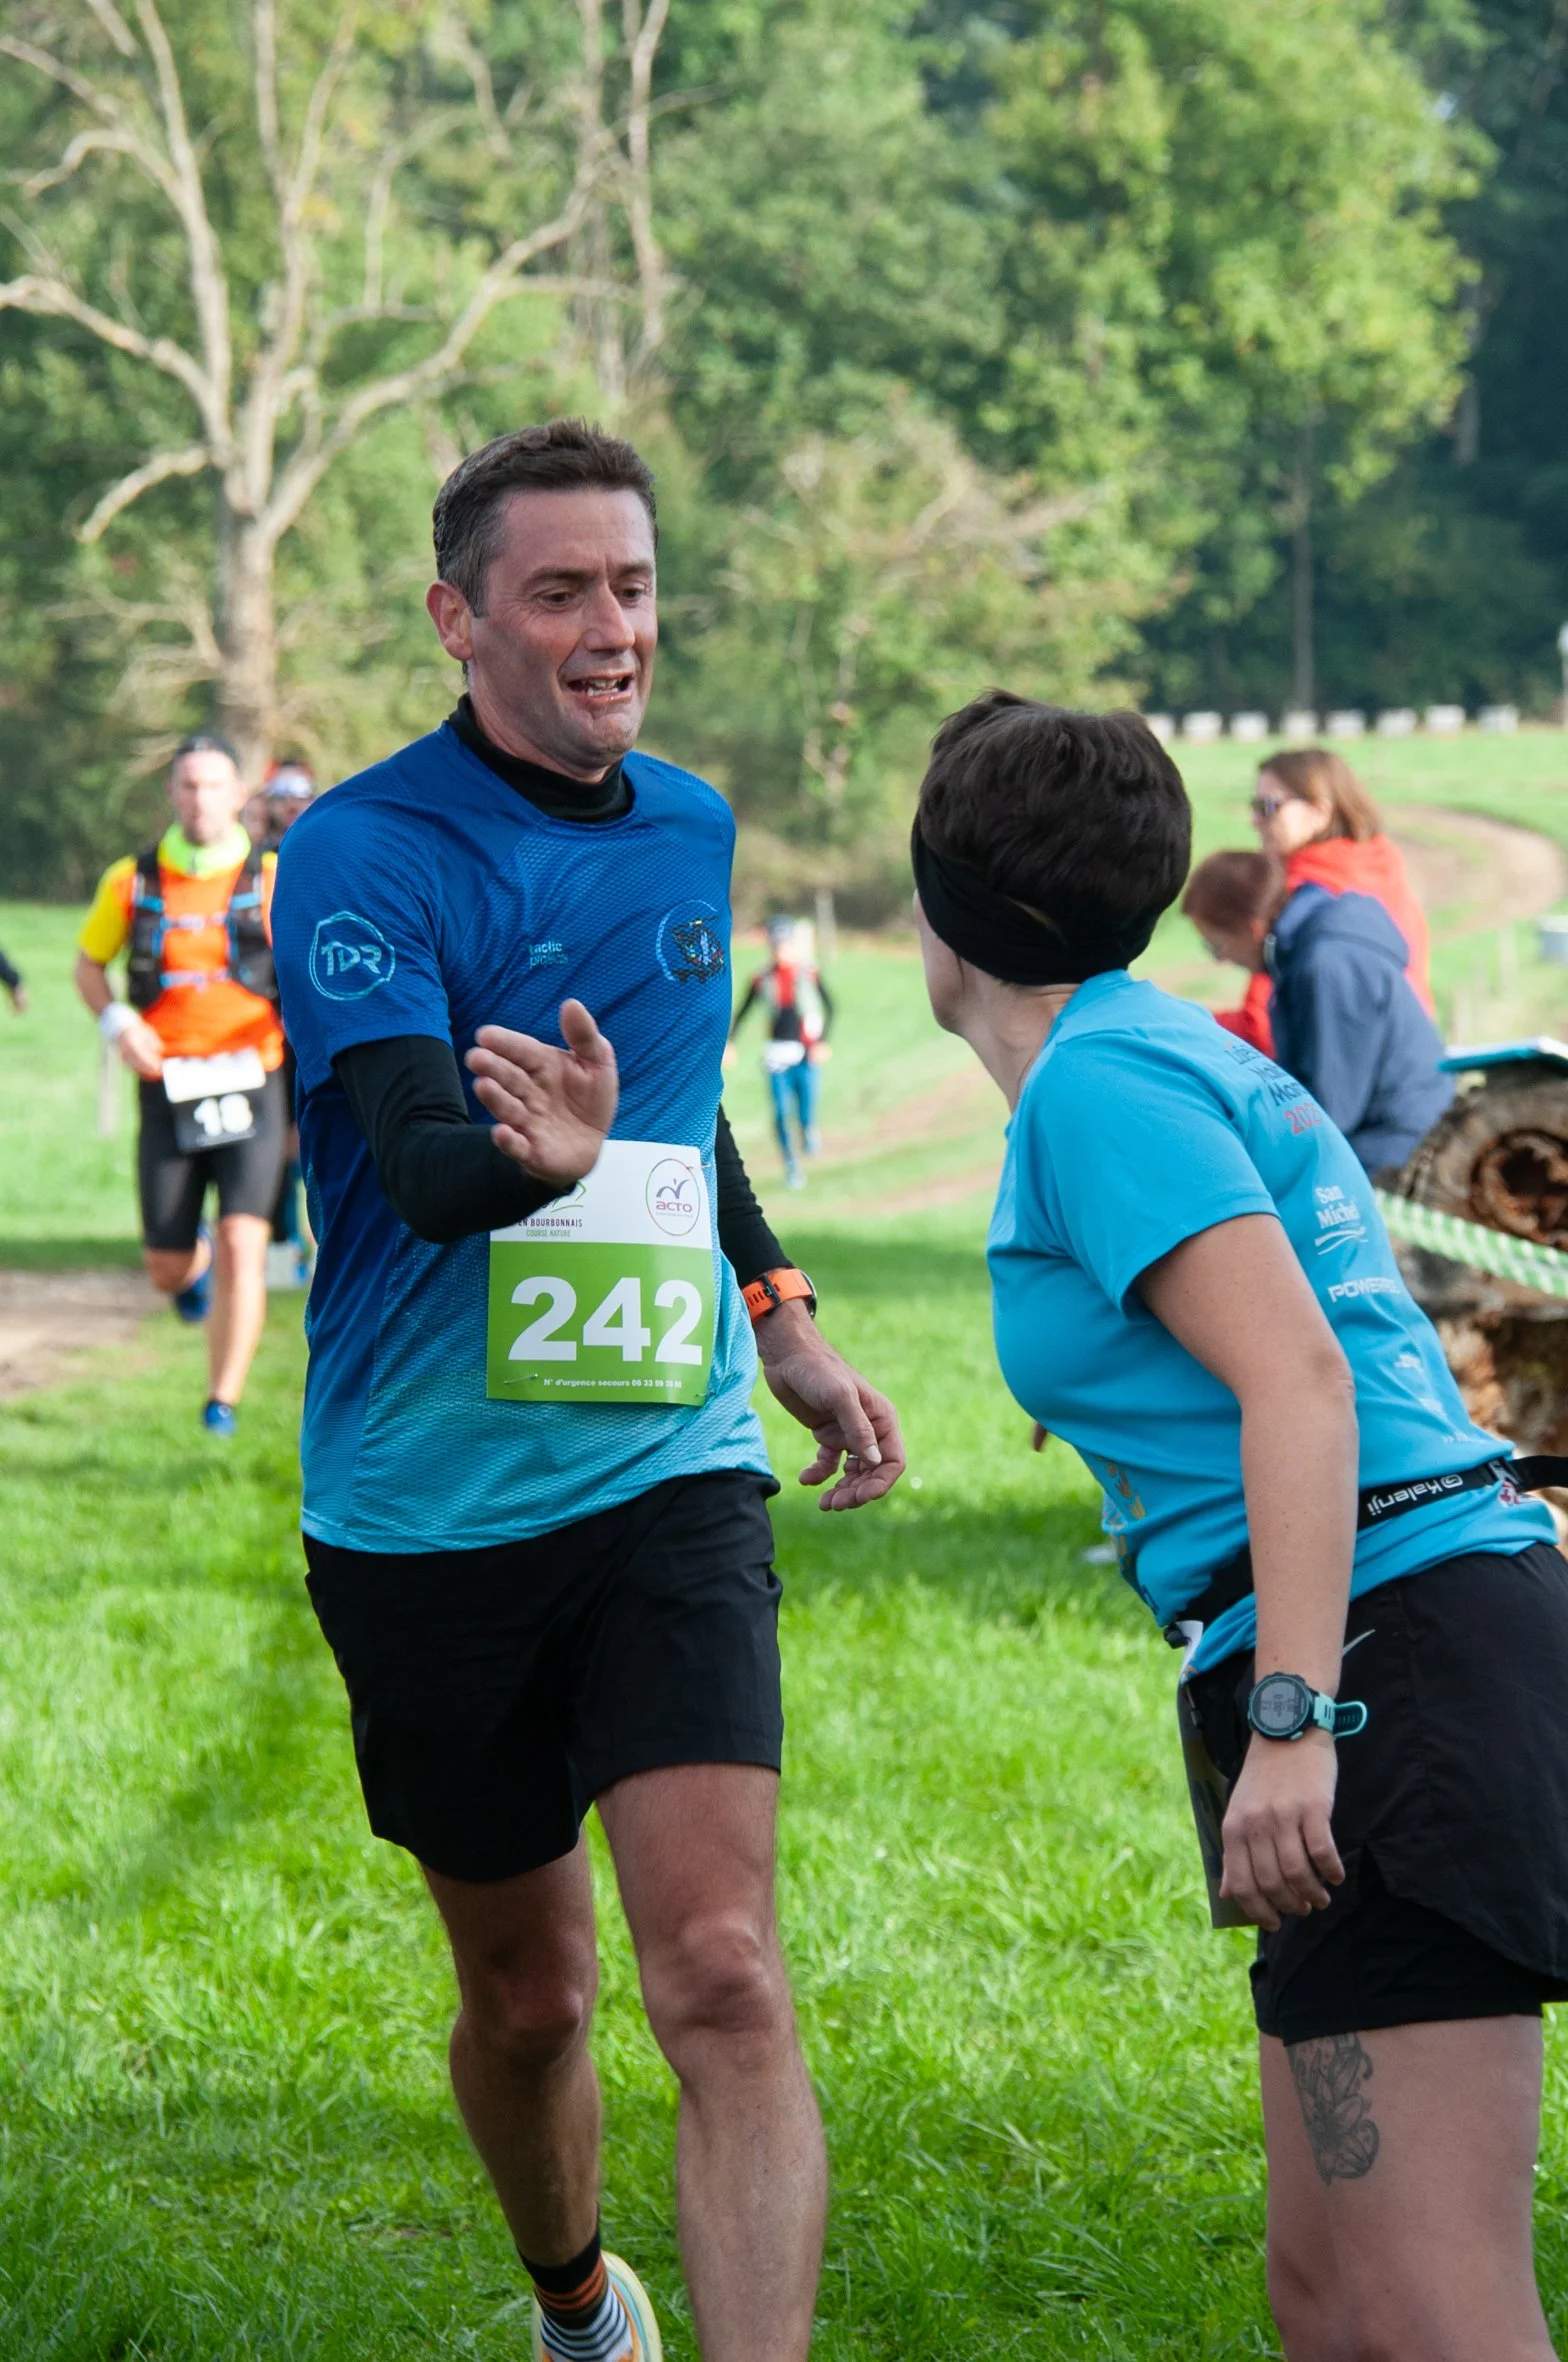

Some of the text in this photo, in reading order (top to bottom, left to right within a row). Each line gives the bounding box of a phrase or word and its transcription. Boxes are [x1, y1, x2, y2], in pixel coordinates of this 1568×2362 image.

[321, 941, 382, 976] TDR
[530, 1218, 583, 1228] BOURBONNAIS
[526, 1229, 572, 1238] COURSE NATURE
[507, 1275, 703, 1366] 242
[555, 1378, 596, 1389] d'urgence
[597, 1380, 630, 1388] secours
